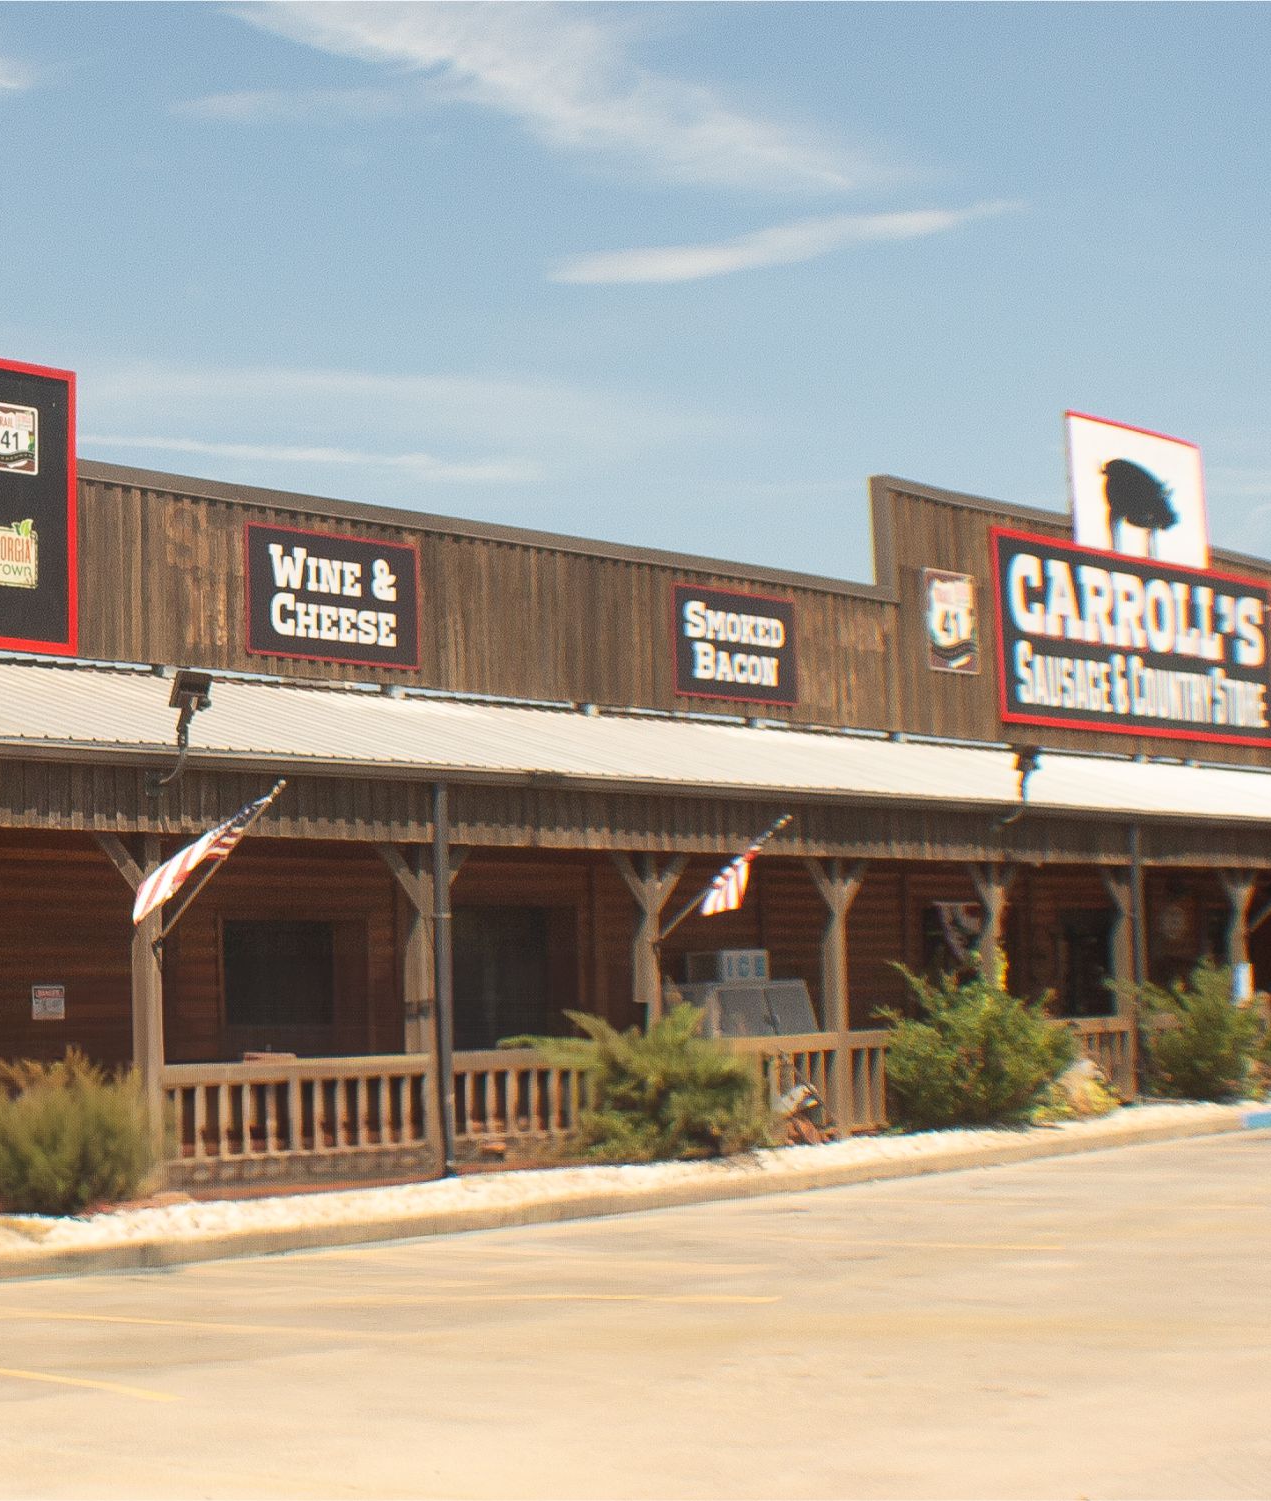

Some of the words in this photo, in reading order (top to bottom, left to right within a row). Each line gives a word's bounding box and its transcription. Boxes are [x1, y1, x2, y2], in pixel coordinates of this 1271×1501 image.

[1, 430, 19, 451] 41
[268, 543, 362, 598] WINE
[371, 558, 397, 602] &
[270, 592, 397, 648] CHEESE
[683, 600, 786, 649] SMOKED
[1007, 553, 1266, 667] CARROLL'S
[692, 641, 779, 687] BACON
[1013, 639, 1113, 713] SAUSAGE
[1110, 653, 1130, 714] &
[1128, 654, 1213, 725] COUNTRY
[1209, 666, 1270, 728] STORE
